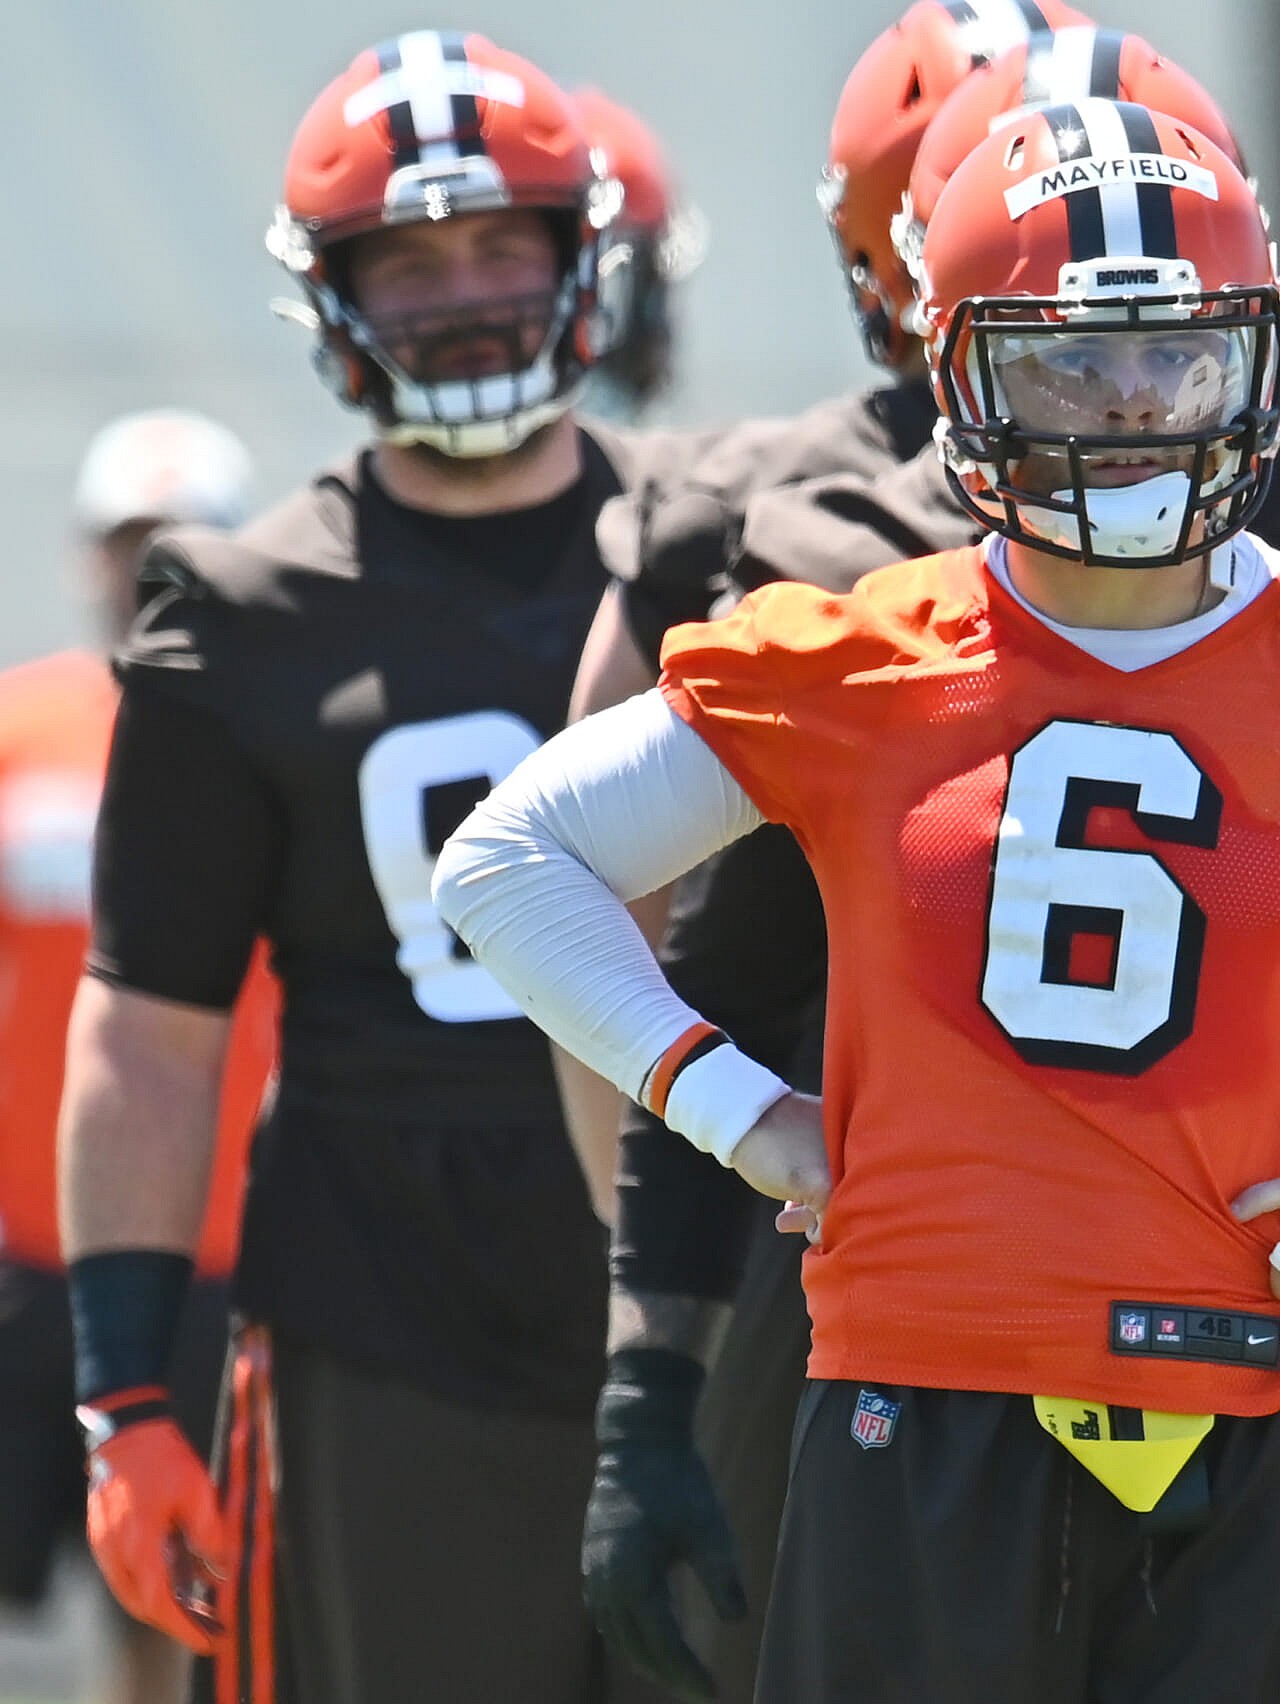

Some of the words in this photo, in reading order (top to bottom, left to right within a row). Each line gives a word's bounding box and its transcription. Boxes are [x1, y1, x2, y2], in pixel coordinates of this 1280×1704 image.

[1041, 159, 1187, 196] MAYFIELD
[1096, 268, 1159, 287] BROWNS
[980, 716, 1223, 1075] 6
[856, 1411, 888, 1441] NFL
